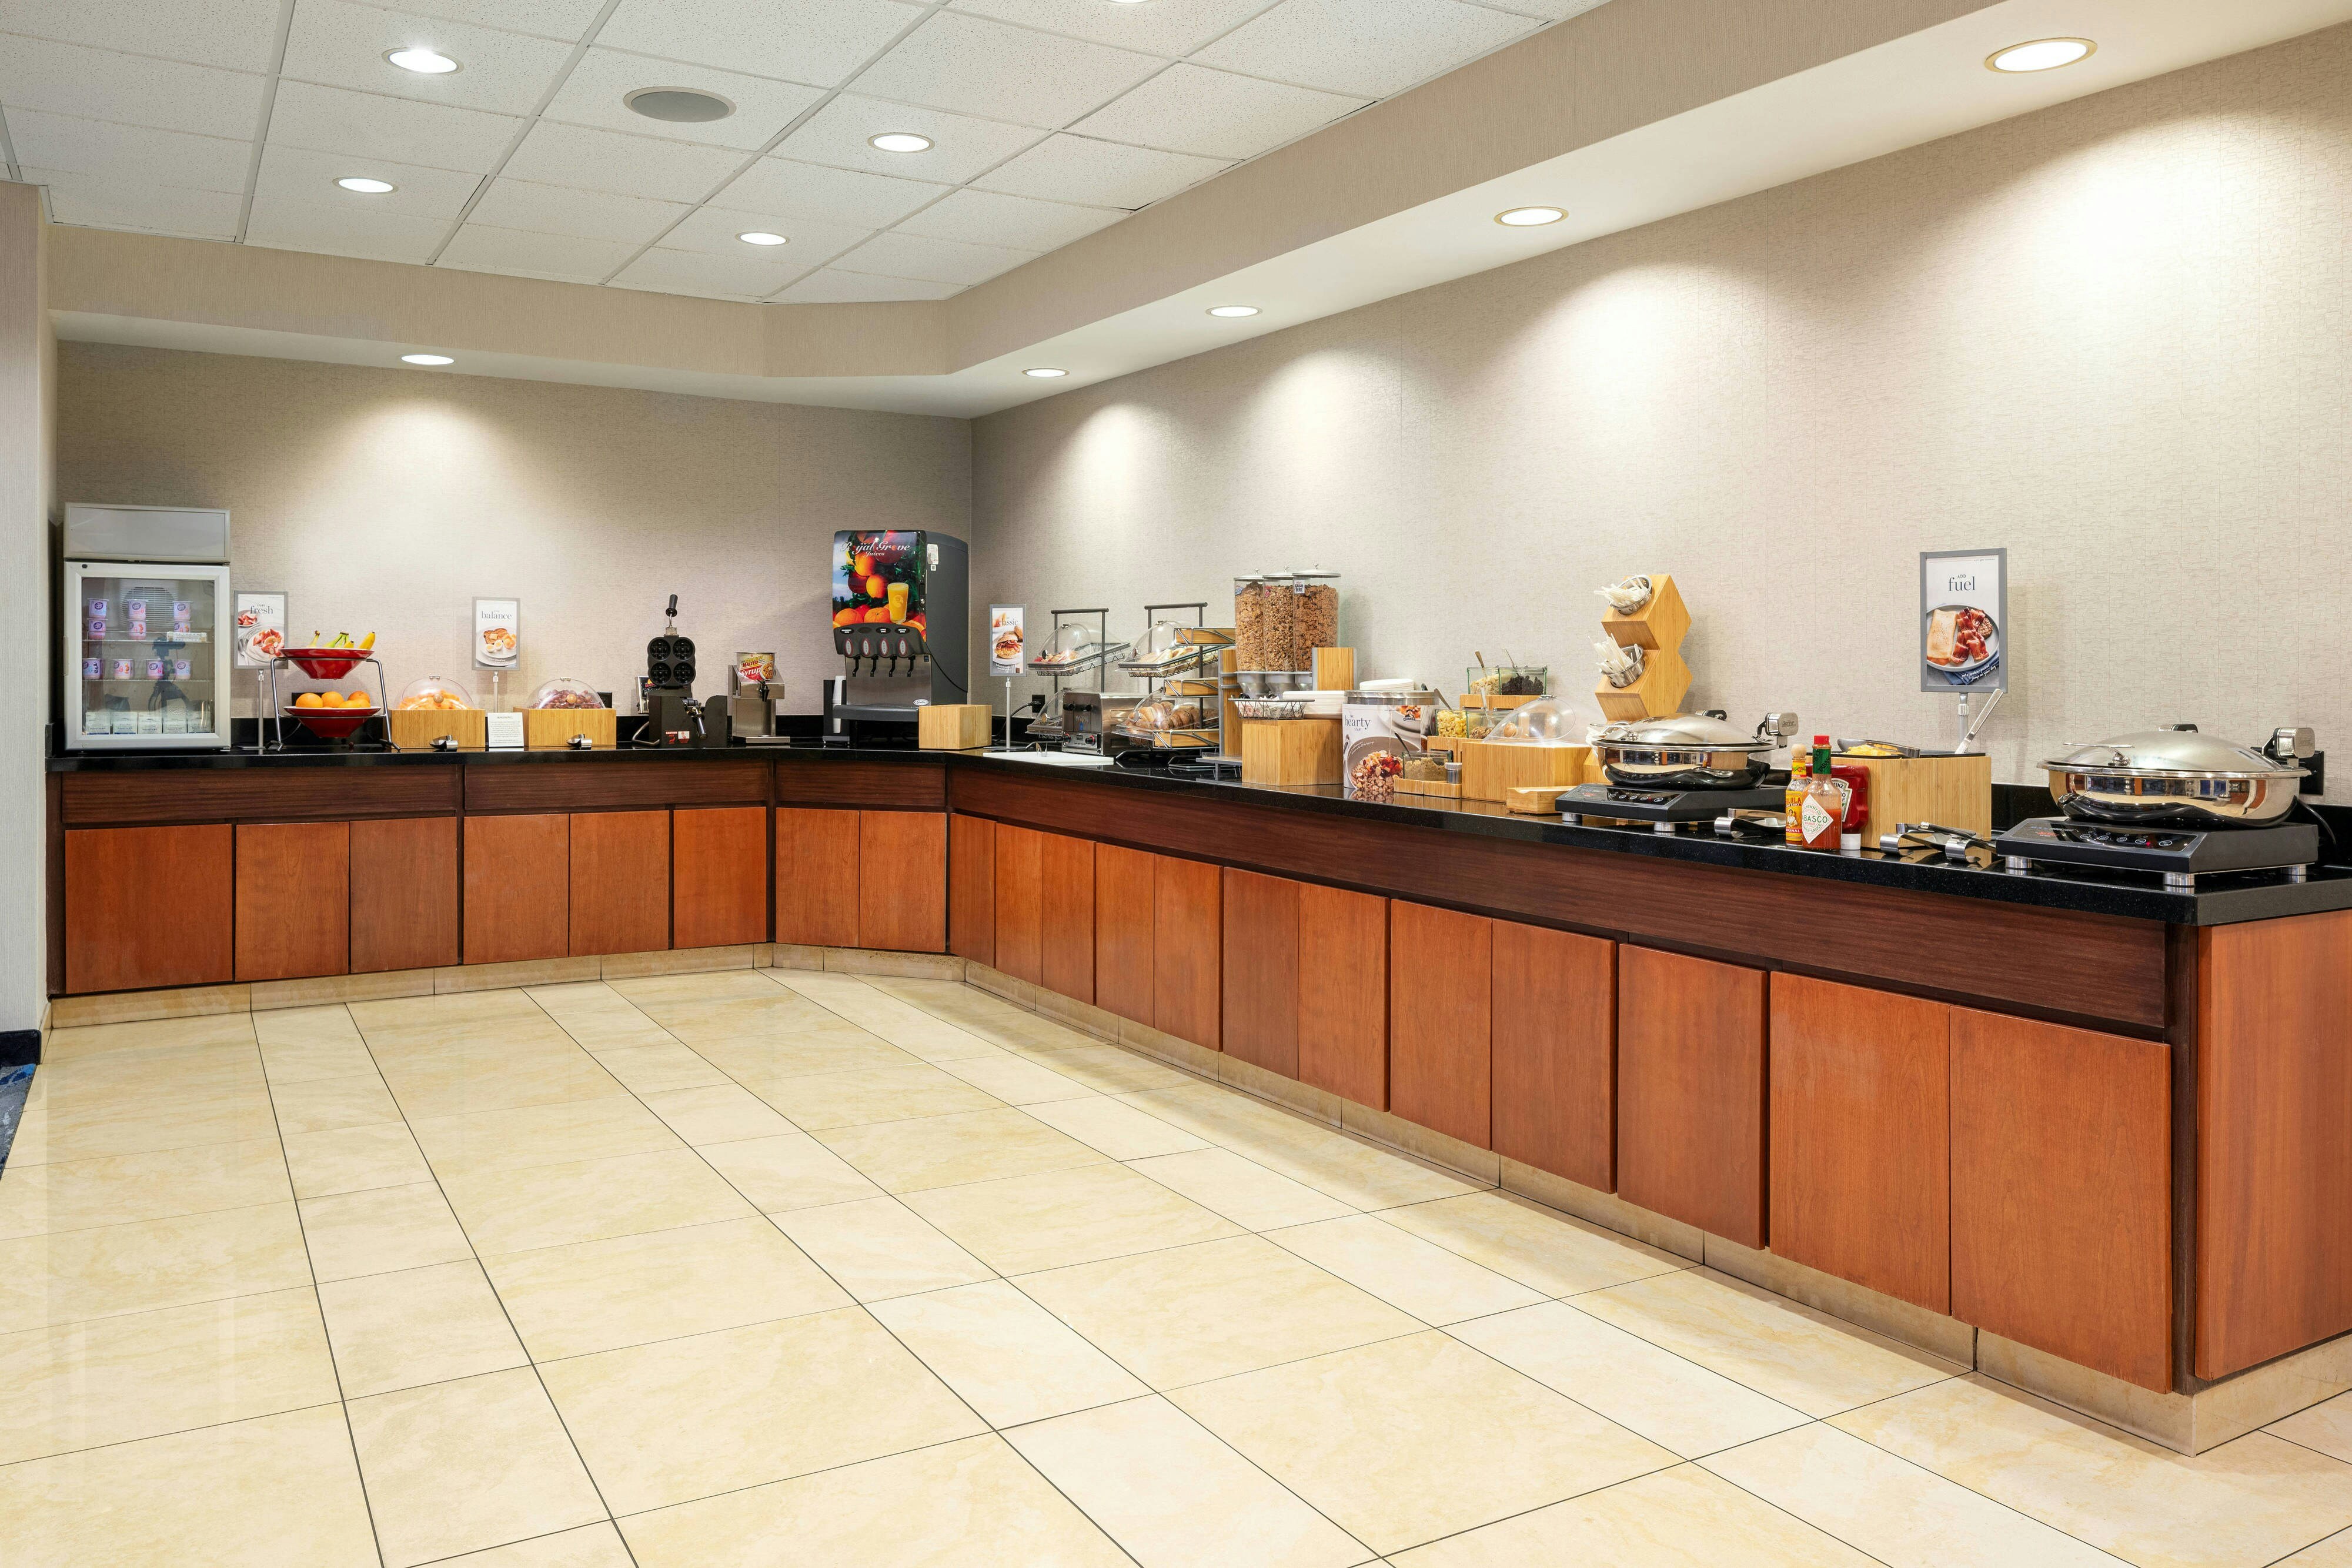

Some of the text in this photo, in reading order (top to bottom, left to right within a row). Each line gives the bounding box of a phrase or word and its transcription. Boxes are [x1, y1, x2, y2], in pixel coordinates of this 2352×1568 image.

[841, 540, 911, 554] Royal Grove
[1948, 576, 1976, 591] fuel
[250, 606, 273, 614] fresh
[482, 611, 512, 620] balance
[998, 618, 1018, 626] classic
[741, 667, 761, 677] Syrup
[1345, 715, 1371, 730] hearty
[1802, 814, 1828, 823] BASCO
